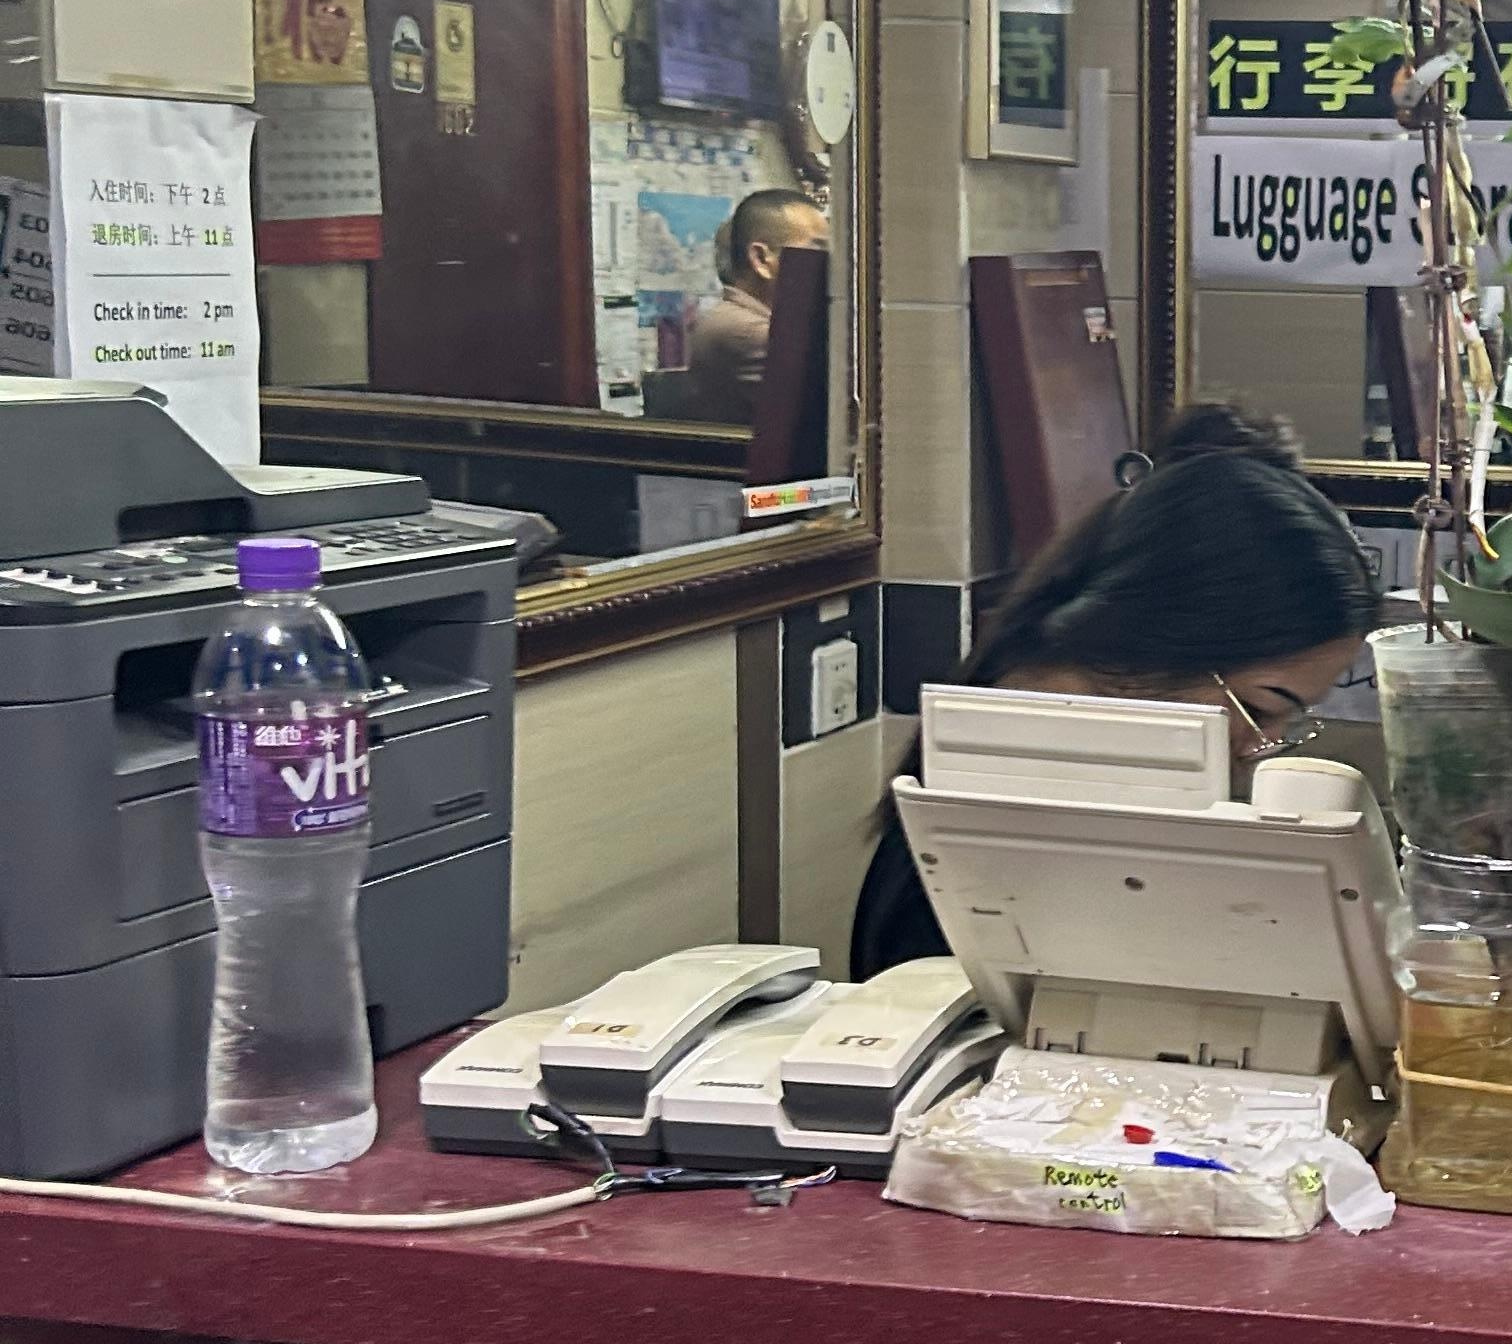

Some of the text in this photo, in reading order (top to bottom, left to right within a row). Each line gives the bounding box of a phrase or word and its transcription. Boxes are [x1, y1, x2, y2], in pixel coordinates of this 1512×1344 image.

[161, 181, 193, 205] 下午
[202, 187, 210, 204] 2
[214, 185, 226, 206] 点
[1213, 153, 1397, 265] Lugguage
[167, 223, 195, 246] 上午
[204, 229, 218, 246] 11
[222, 225, 234, 247] 点
[94, 301, 234, 322] Check in time: 2 pm
[95, 342, 236, 363] Check out time: 11 am
[1044, 1165, 1119, 1189] Remote
[1058, 1191, 1127, 1212] control
